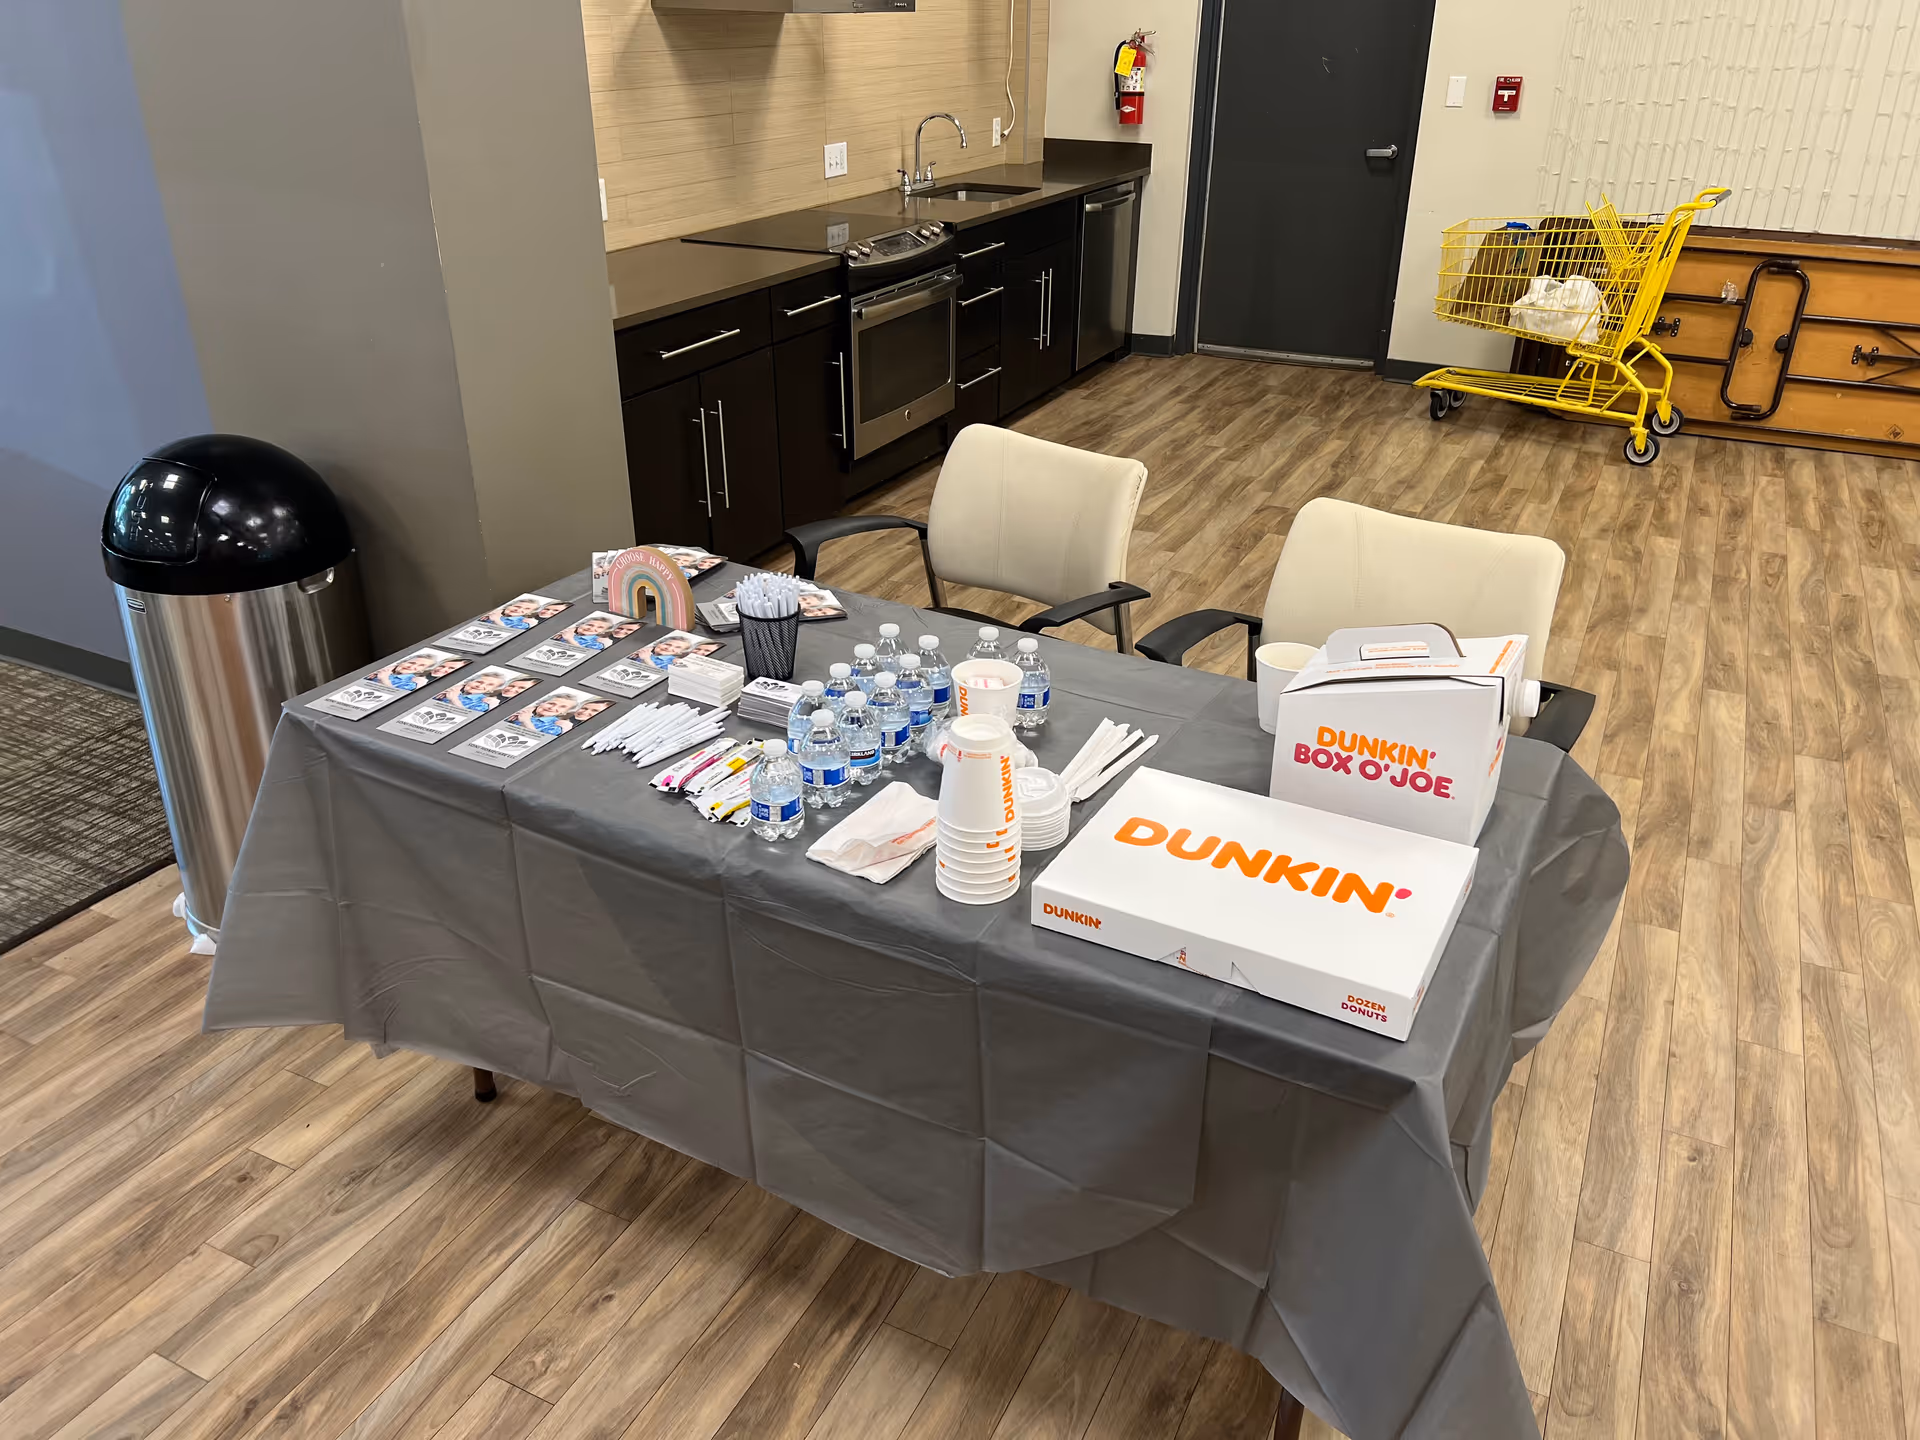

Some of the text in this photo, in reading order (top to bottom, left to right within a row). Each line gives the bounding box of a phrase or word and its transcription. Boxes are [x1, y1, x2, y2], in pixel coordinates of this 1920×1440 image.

[616, 551, 674, 581] CHOOSE HAPPY
[1294, 743, 1353, 775] BOX
[1317, 726, 1436, 770] DUNKIN'
[1000, 755, 1015, 823] DUNKIN'
[1113, 816, 1412, 914] DUNKIN'
[1043, 902, 1102, 929] DUNKIN'
[1341, 1002, 1388, 1023] DONUTS
[1347, 994, 1386, 1013] DOZEN
